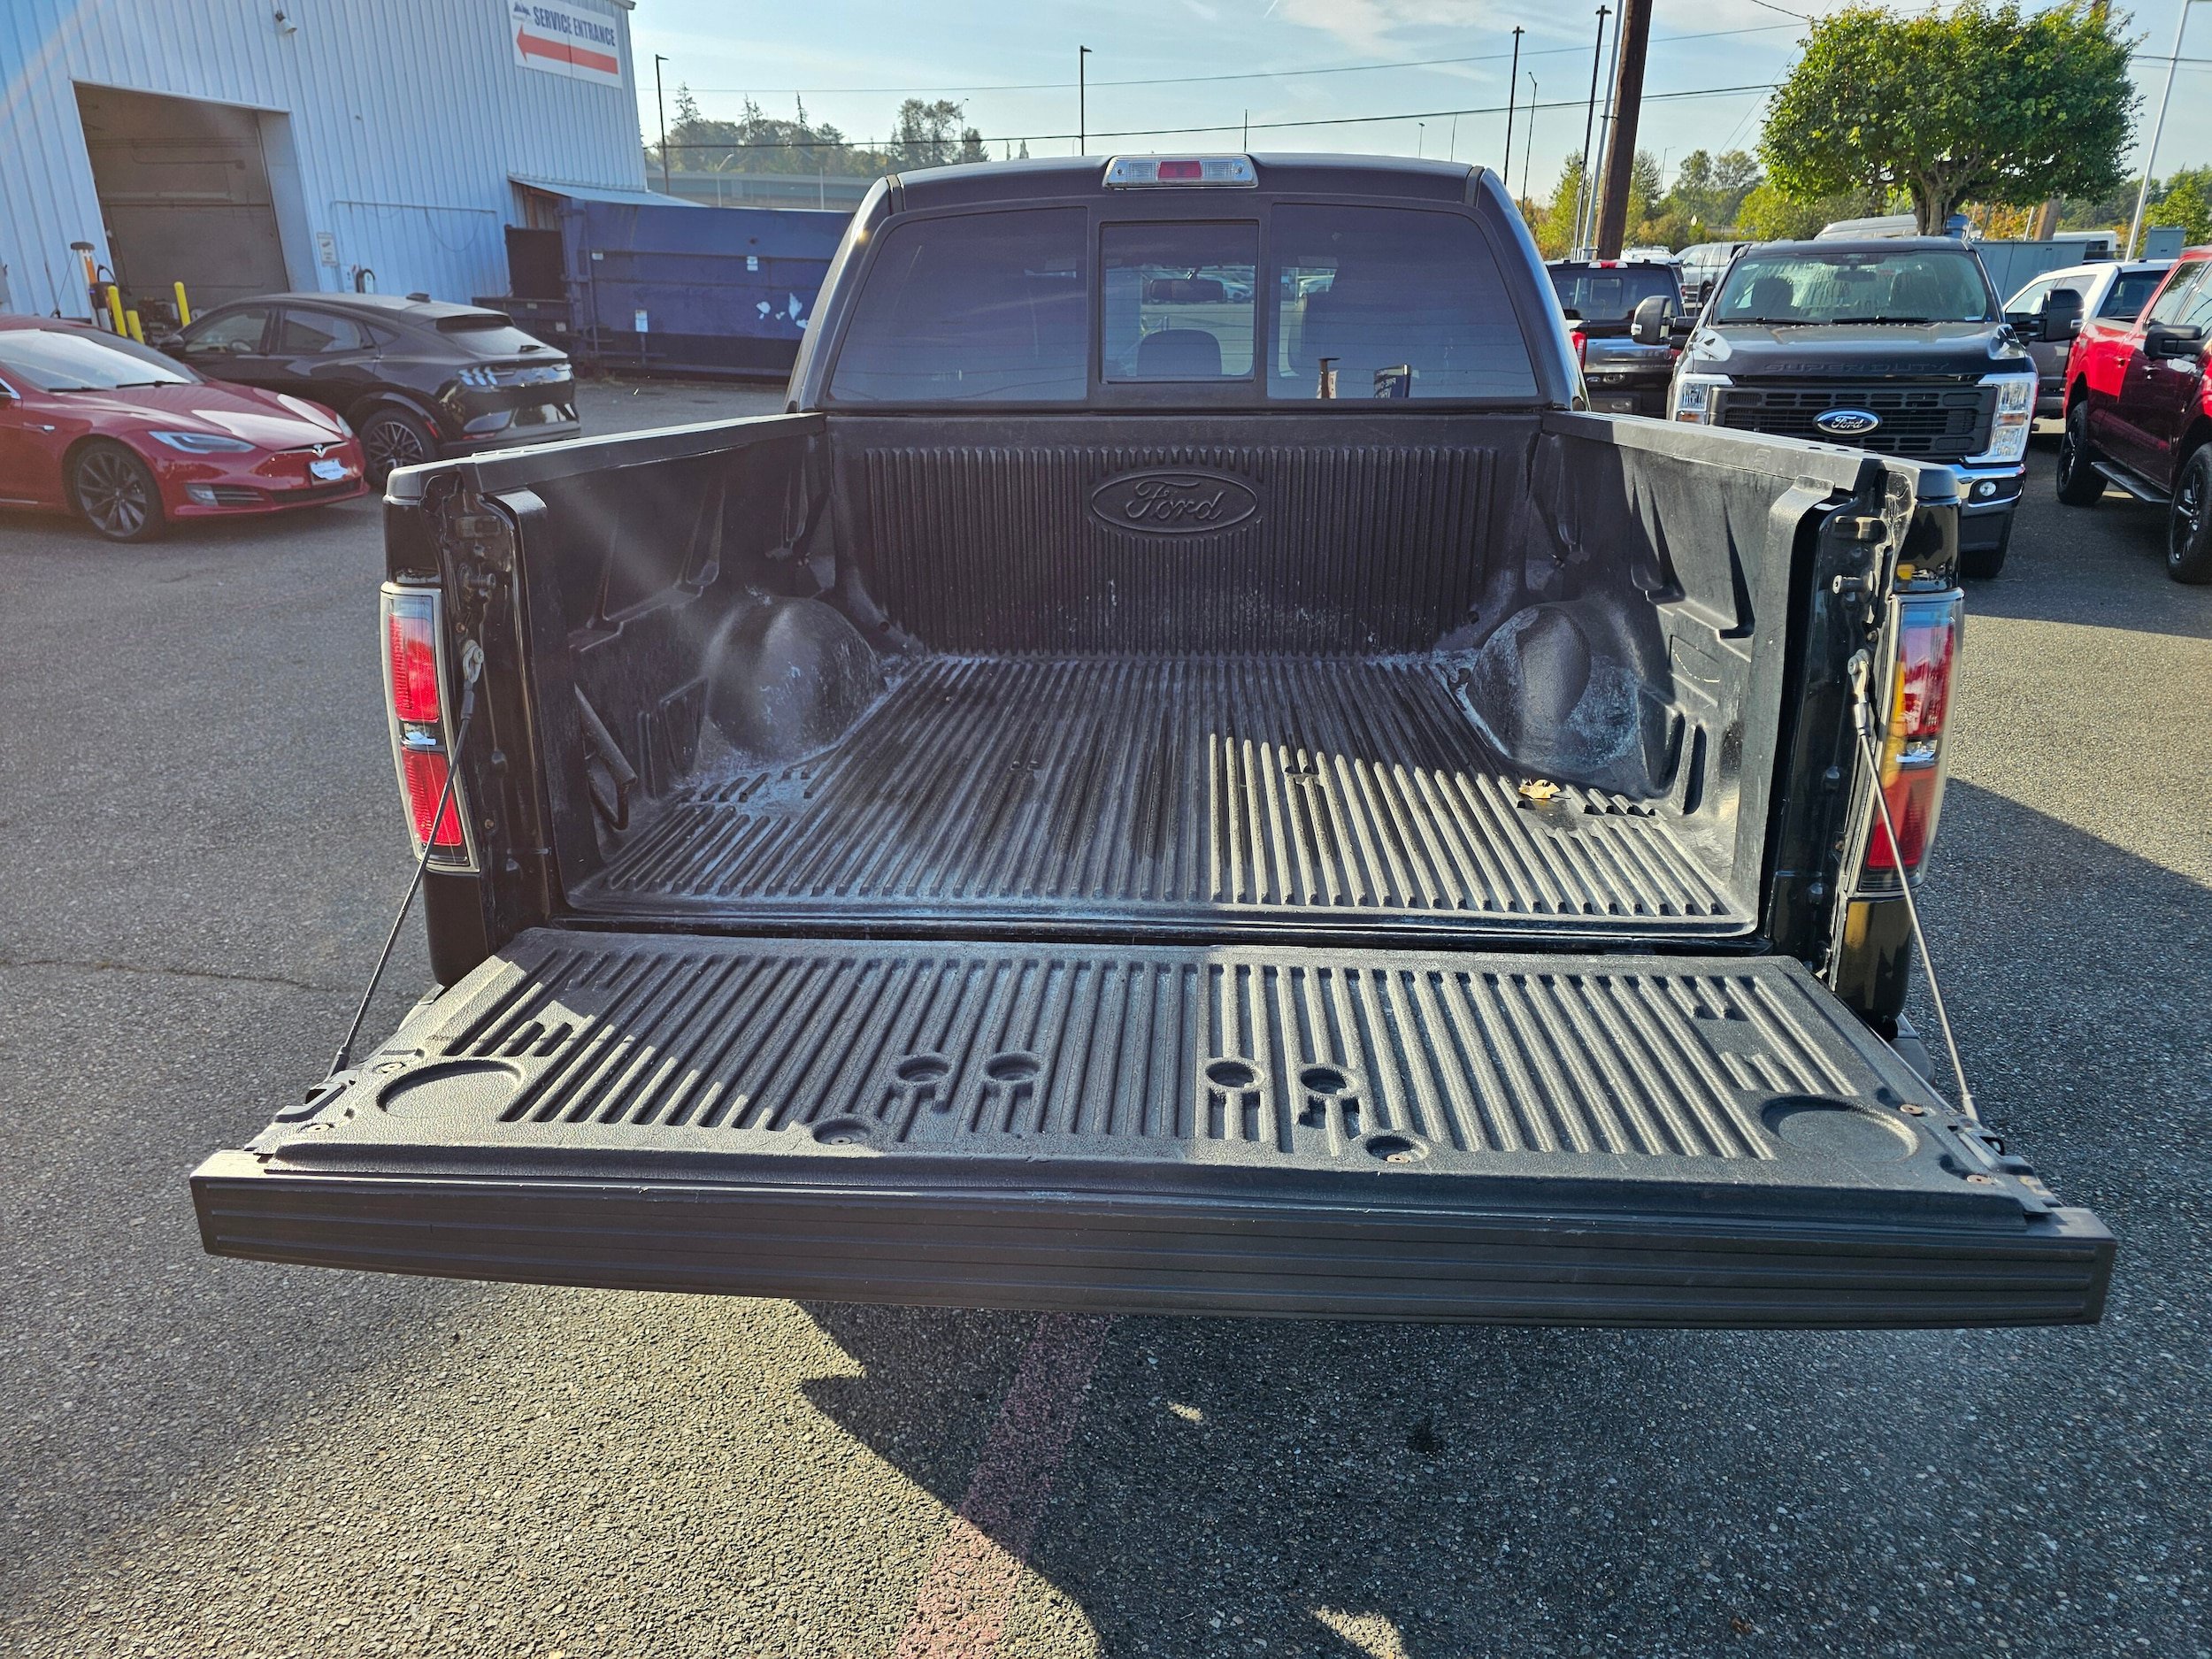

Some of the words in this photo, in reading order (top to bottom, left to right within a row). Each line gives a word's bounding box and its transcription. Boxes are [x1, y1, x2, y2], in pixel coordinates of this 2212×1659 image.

[533, 5, 572, 35] SERVICE
[572, 17, 616, 47] ENTRANCE
[1764, 362, 1864, 373] SUPER
[1869, 362, 1949, 373] DUTY
[1831, 415, 1864, 429] Ford
[1125, 480, 1226, 519] Ford
